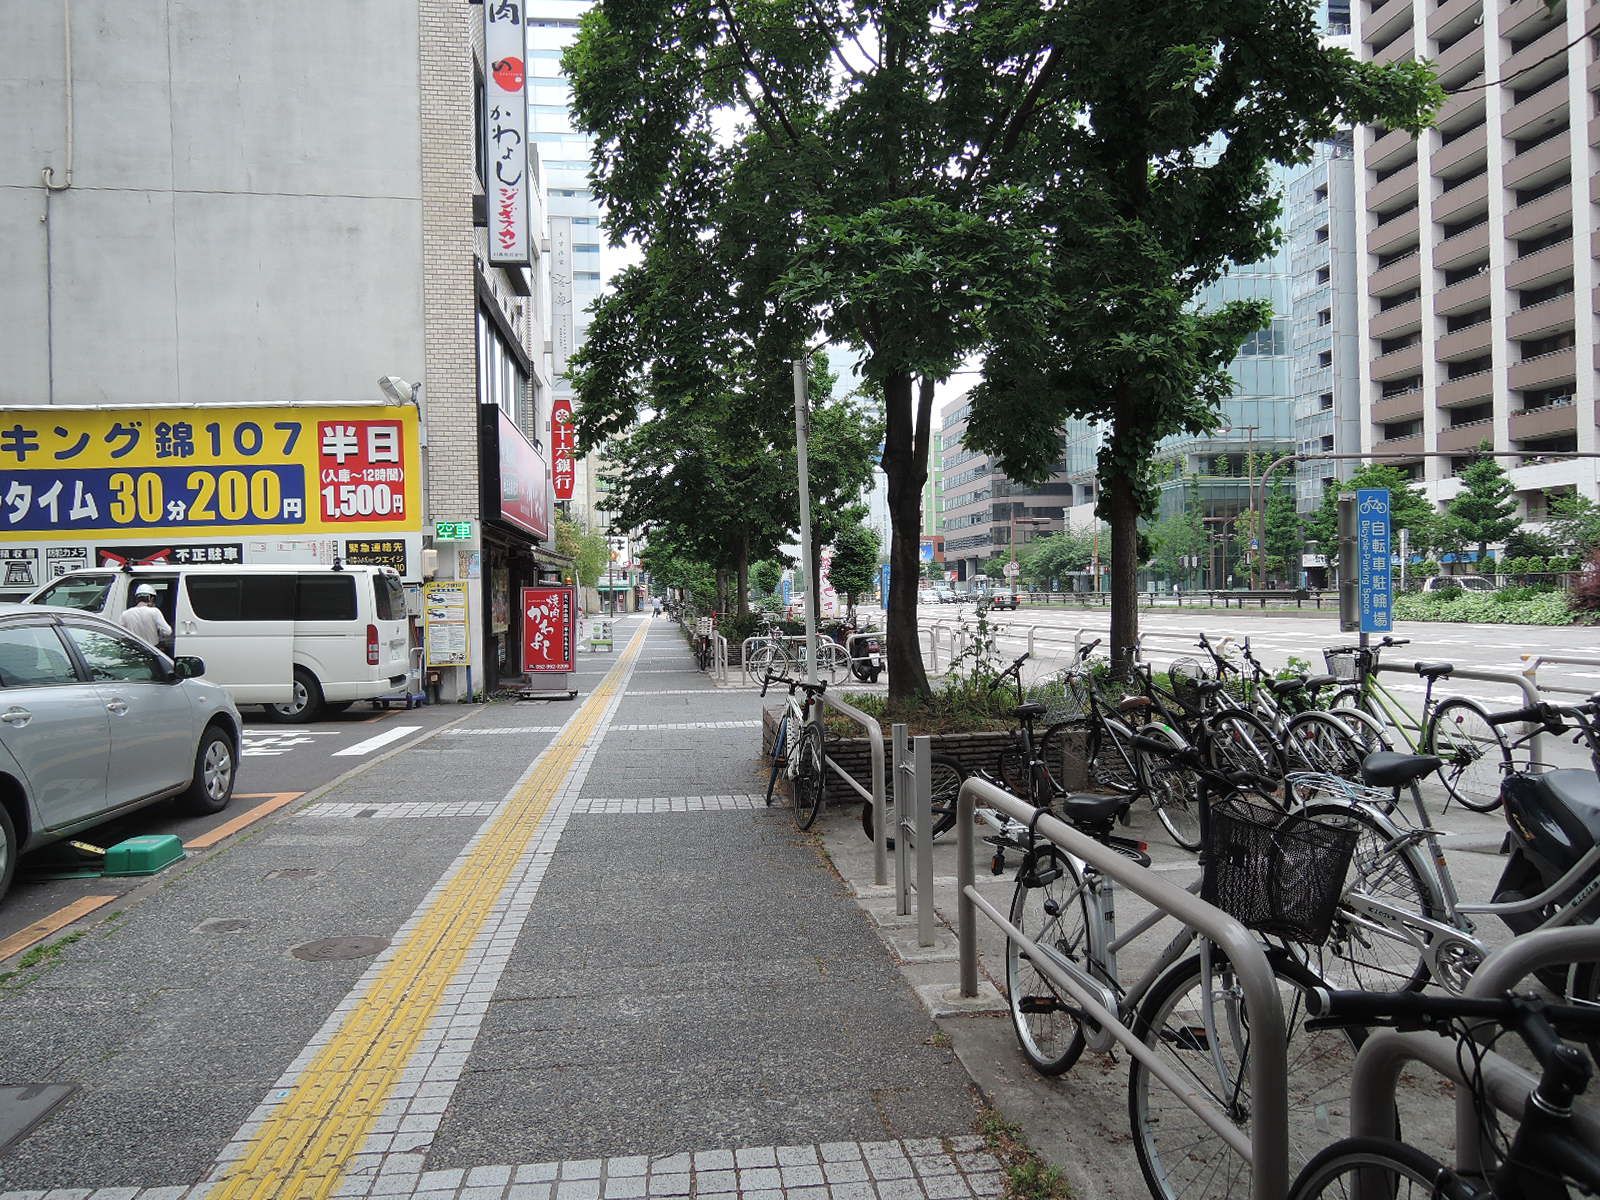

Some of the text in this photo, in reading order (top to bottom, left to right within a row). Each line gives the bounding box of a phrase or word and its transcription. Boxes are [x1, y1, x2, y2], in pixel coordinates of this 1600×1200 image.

[498, 187, 519, 250] ジンギスカン
[0, 421, 303, 462] キング錦107
[322, 425, 399, 465] 半日
[553, 424, 572, 490] 十六銀行
[0, 480, 99, 524] タイム
[321, 483, 404, 519] 1,500円
[348, 542, 404, 553] 緊急連絡先
[436, 521, 473, 540] 空車
[175, 546, 238, 562] 不正駐車
[1371, 520, 1388, 627] 自転車駐輪場
[1362, 588, 1371, 615] Space
